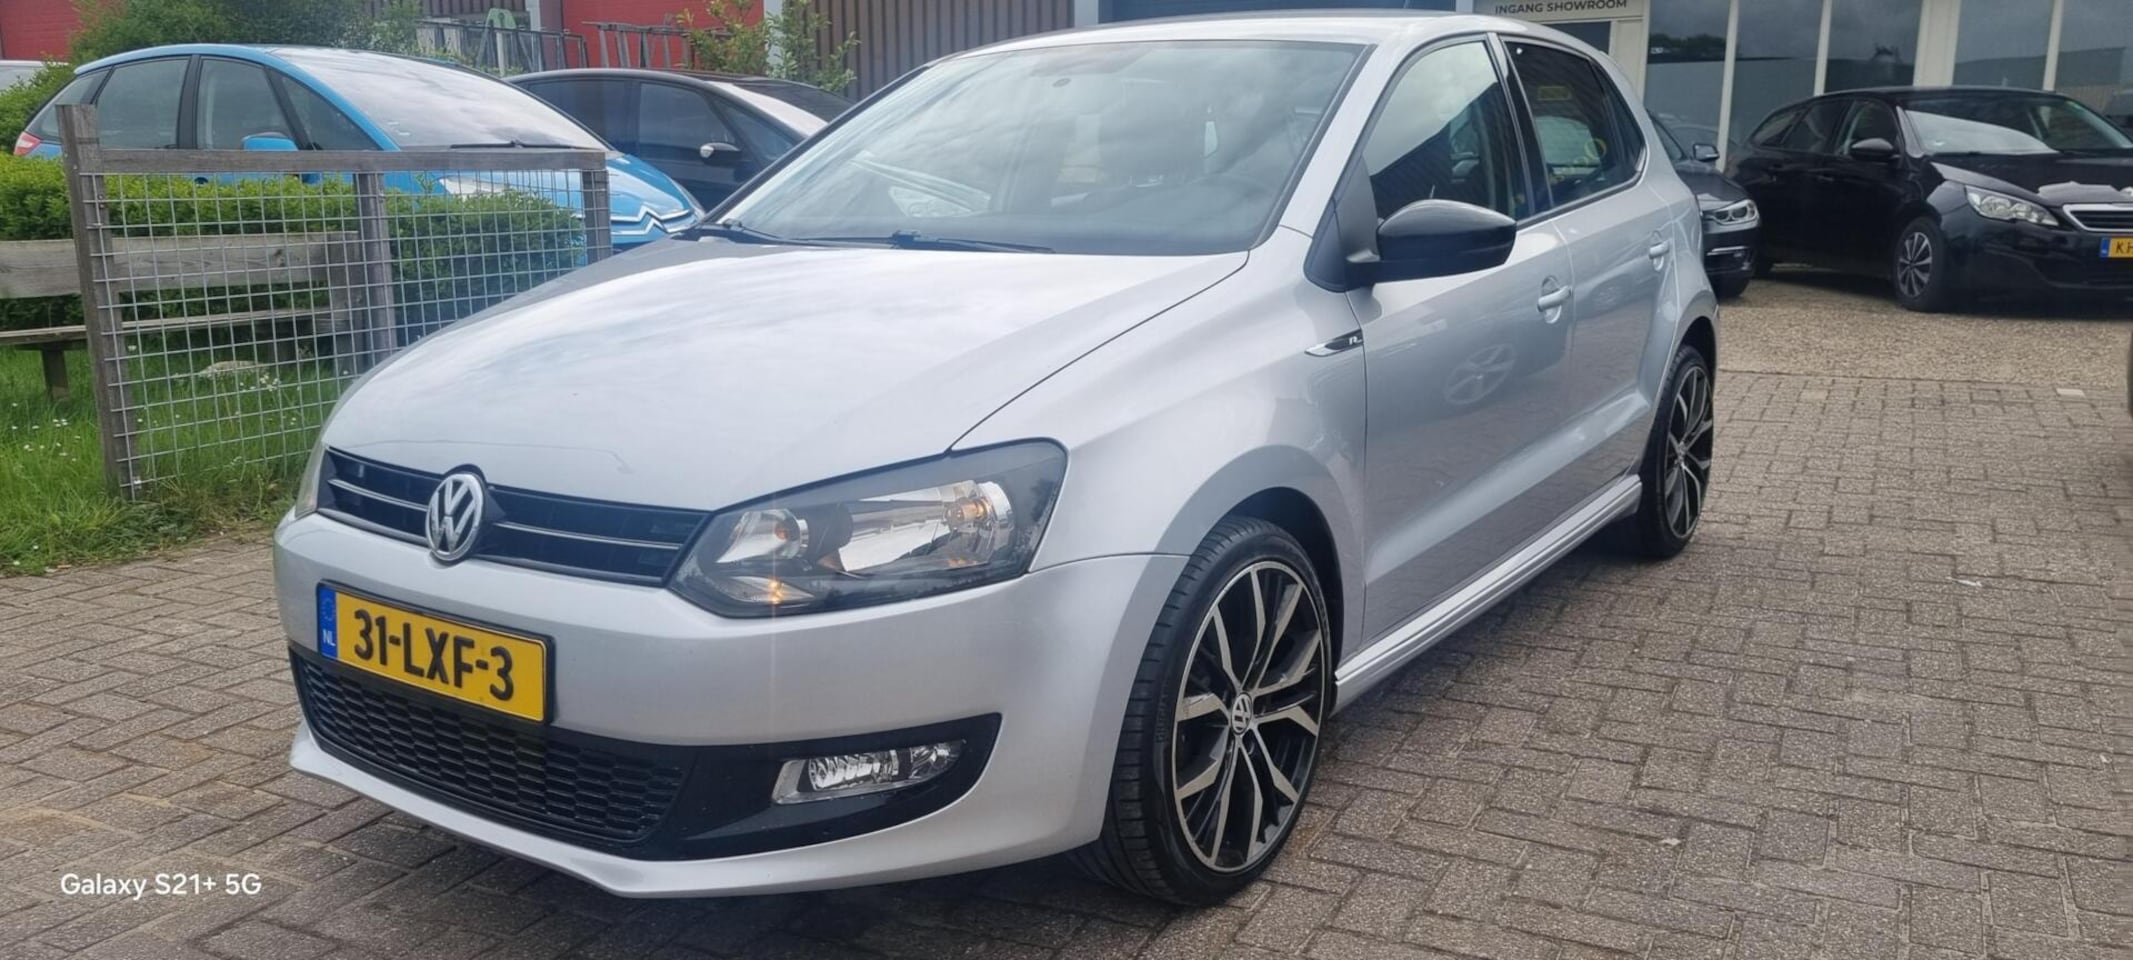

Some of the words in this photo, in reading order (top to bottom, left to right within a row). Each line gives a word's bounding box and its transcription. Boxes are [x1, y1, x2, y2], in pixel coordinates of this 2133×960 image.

[1495, 3, 1543, 15] INGANG
[1547, 0, 1627, 12] SHOWROOM
[322, 629, 337, 648] NL
[353, 610, 515, 702] 31-LXF-3
